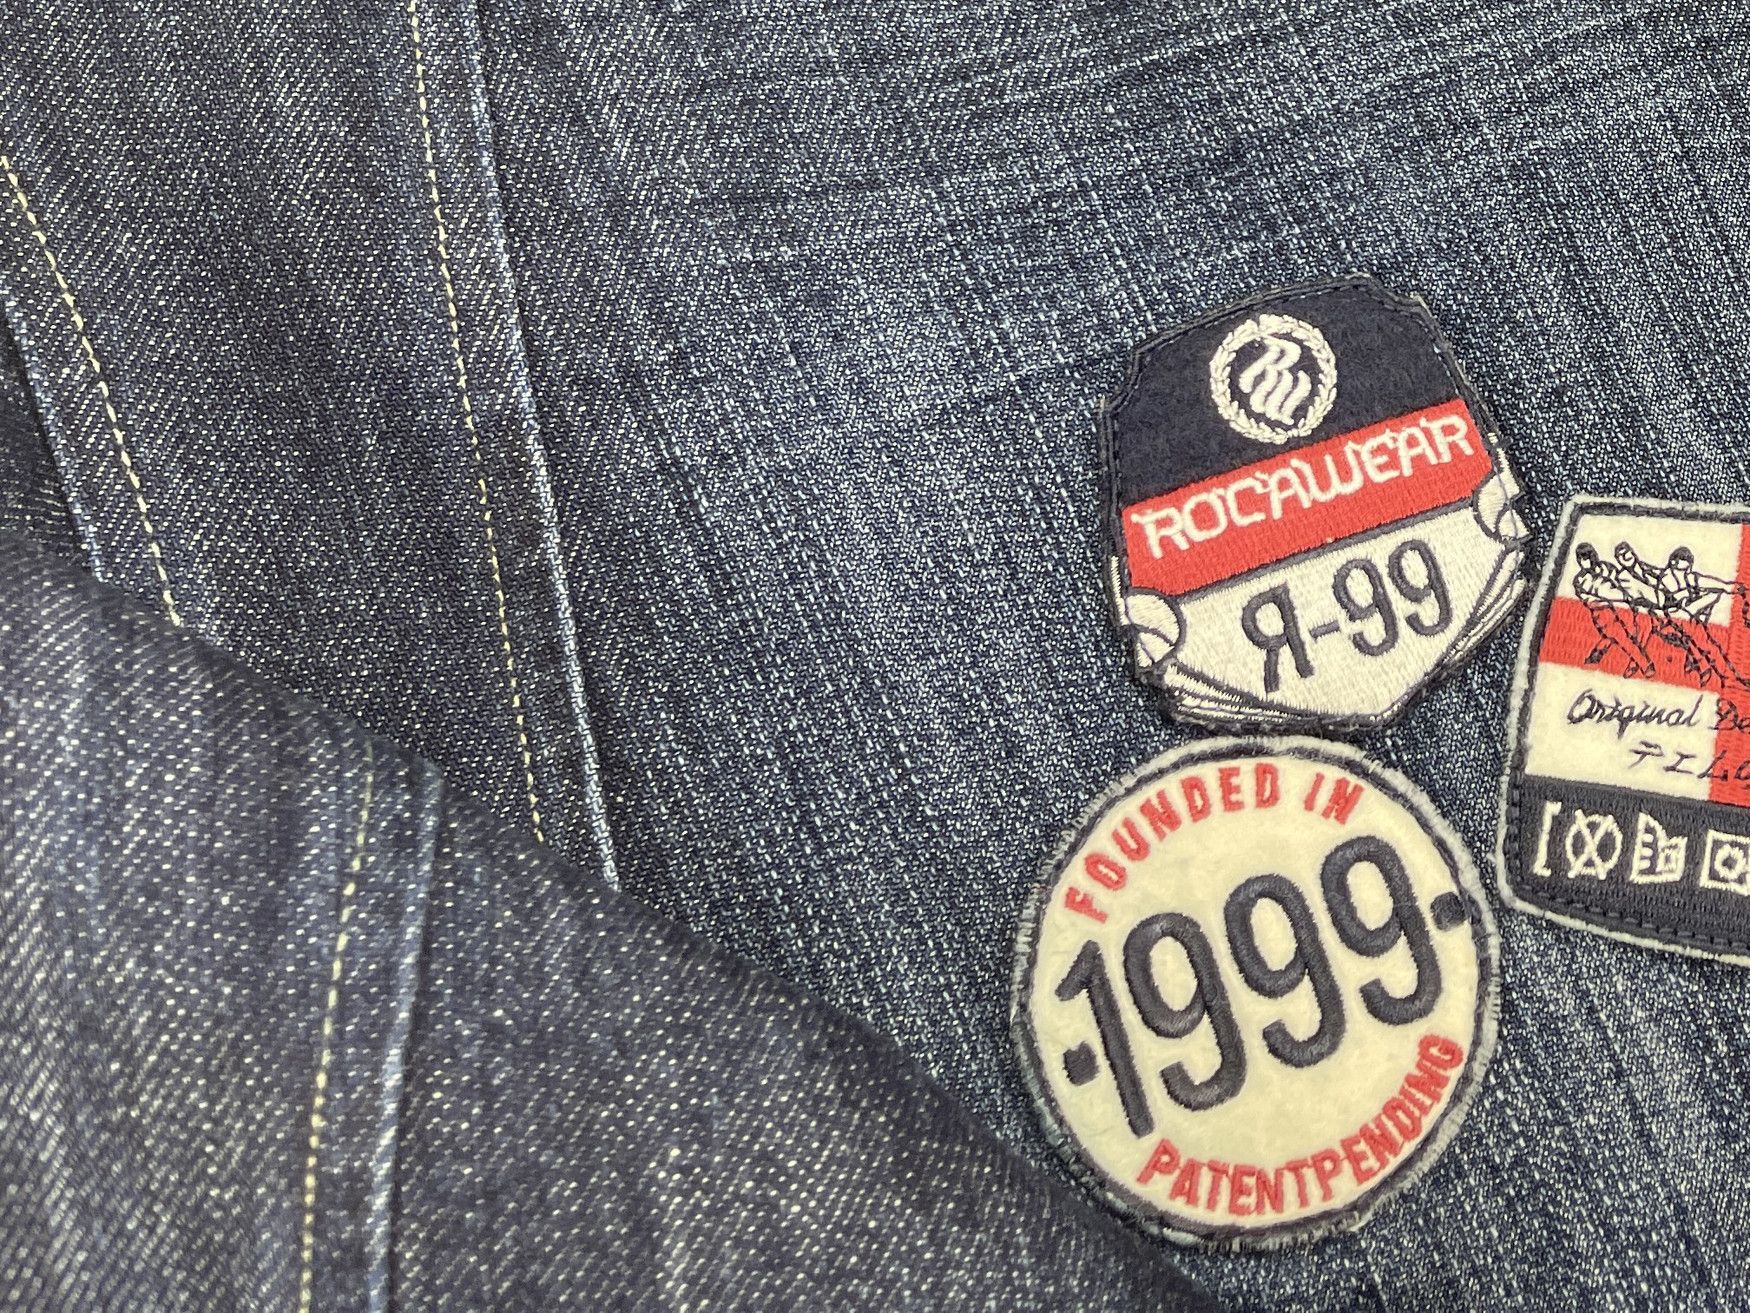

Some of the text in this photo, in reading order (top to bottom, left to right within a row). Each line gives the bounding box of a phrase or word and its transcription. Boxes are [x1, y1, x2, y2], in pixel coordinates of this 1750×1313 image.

[1130, 413, 1474, 559] ROCAWEAR
[1566, 687, 1704, 739] Original
[1063, 761, 1365, 924] FOUNDED IN
